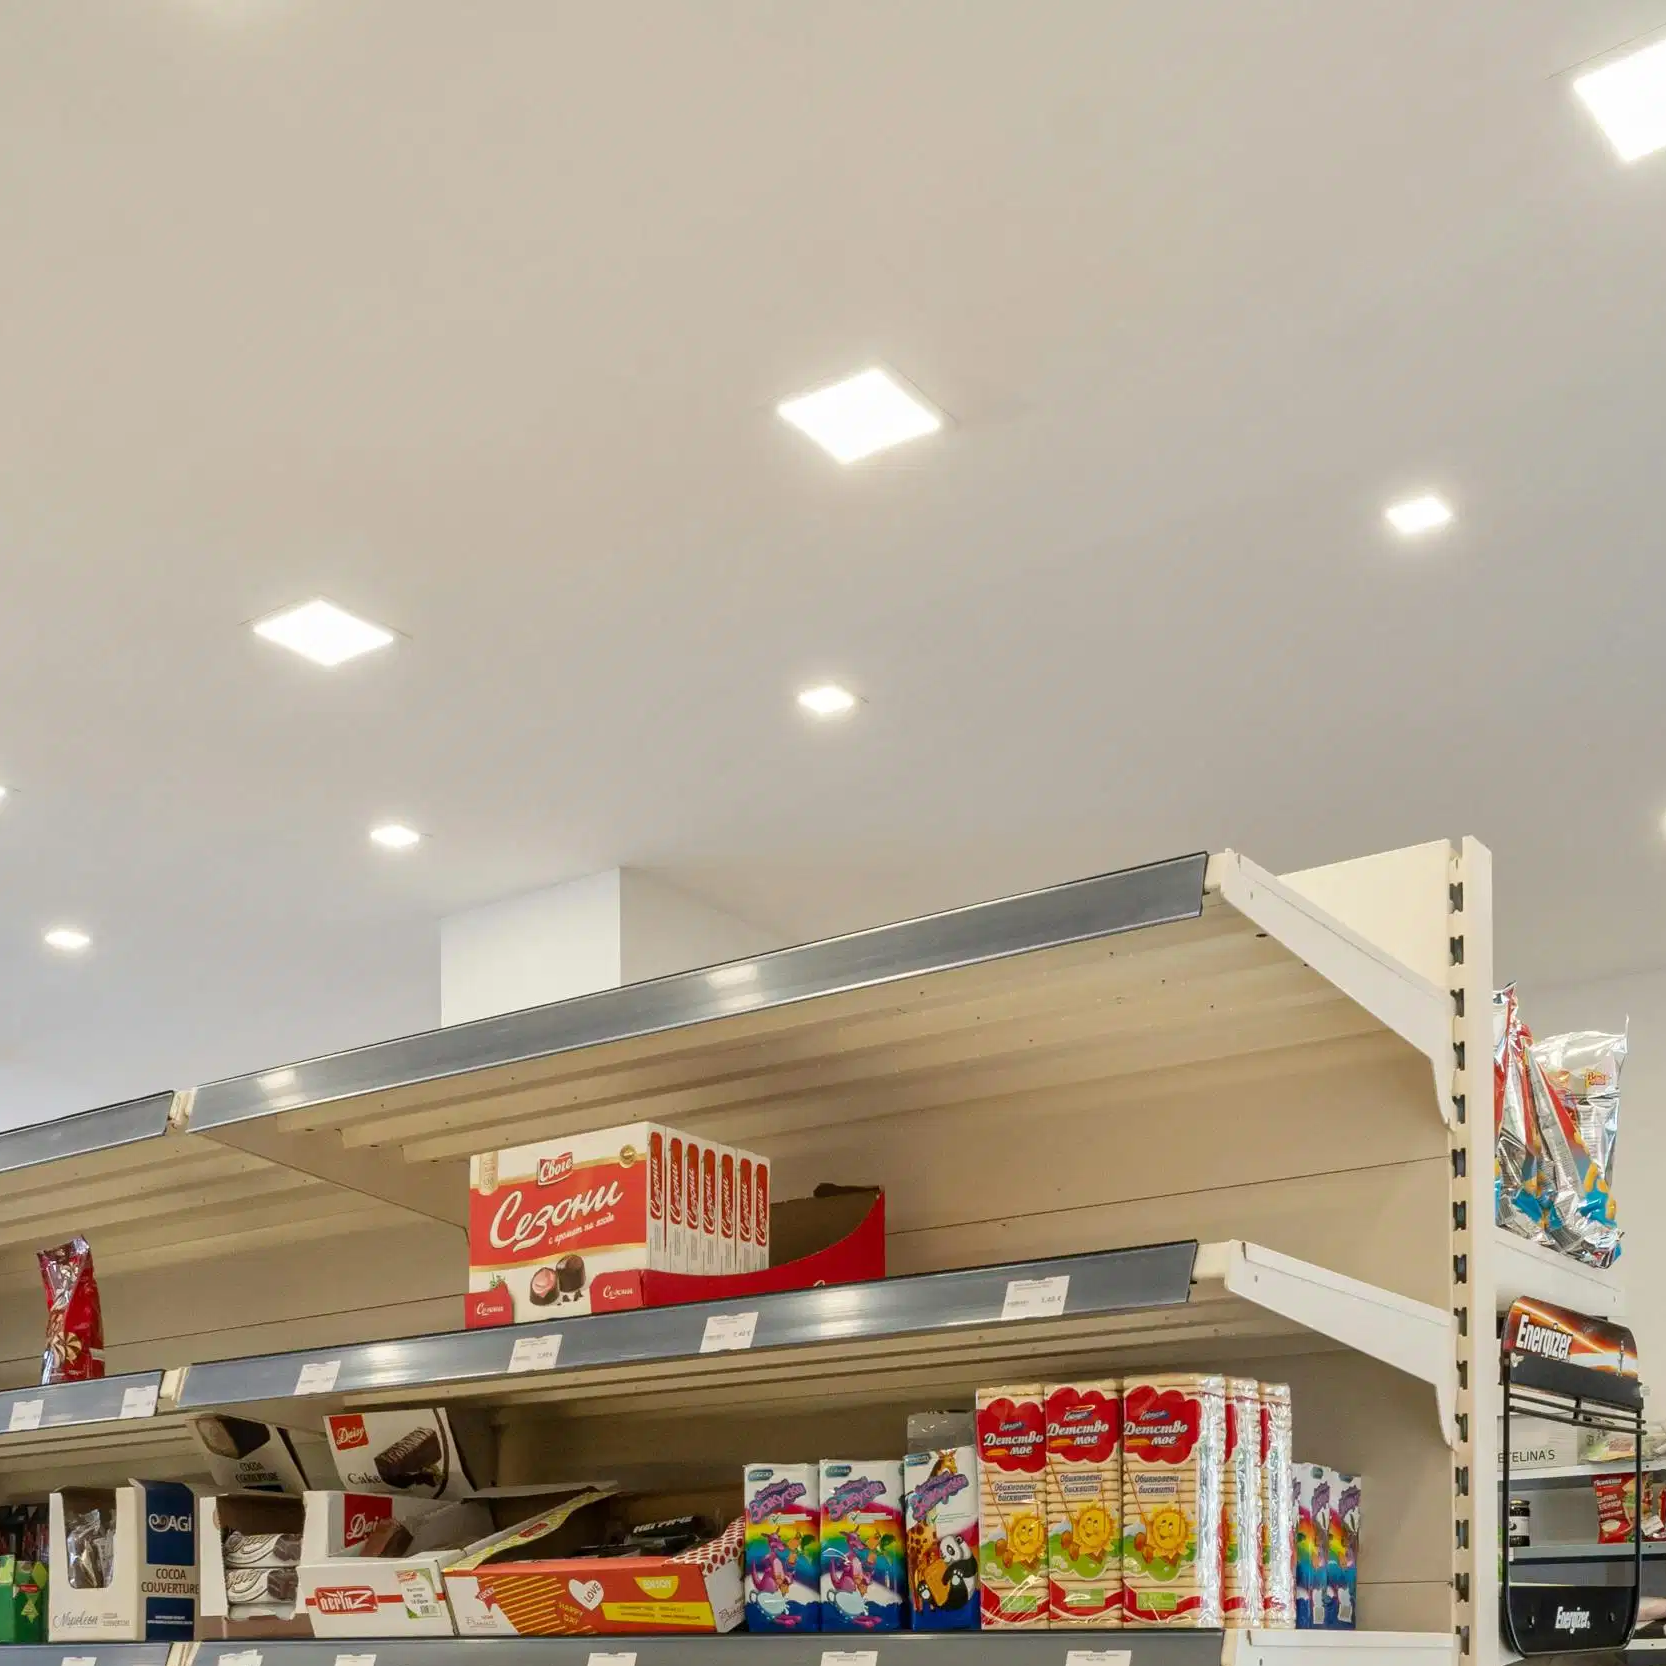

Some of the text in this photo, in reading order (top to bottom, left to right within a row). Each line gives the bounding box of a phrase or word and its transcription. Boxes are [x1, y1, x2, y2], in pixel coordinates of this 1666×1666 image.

[490, 1180, 624, 1253] Сезони
[1516, 1313, 1573, 1360] Energizer
[1047, 1421, 1109, 1437] Детство
[1123, 1420, 1188, 1437] Детство
[984, 1433, 1044, 1448] Детство
[1074, 1434, 1098, 1446] мое
[1151, 1434, 1176, 1447] мое
[1010, 1445, 1033, 1456] мое
[346, 1512, 381, 1541] Dai
[155, 1568, 187, 1580] COCOA
[141, 1581, 200, 1595] COUVERTURE
[583, 1581, 602, 1603] LOVE
[1555, 1606, 1591, 1635] Energizer
